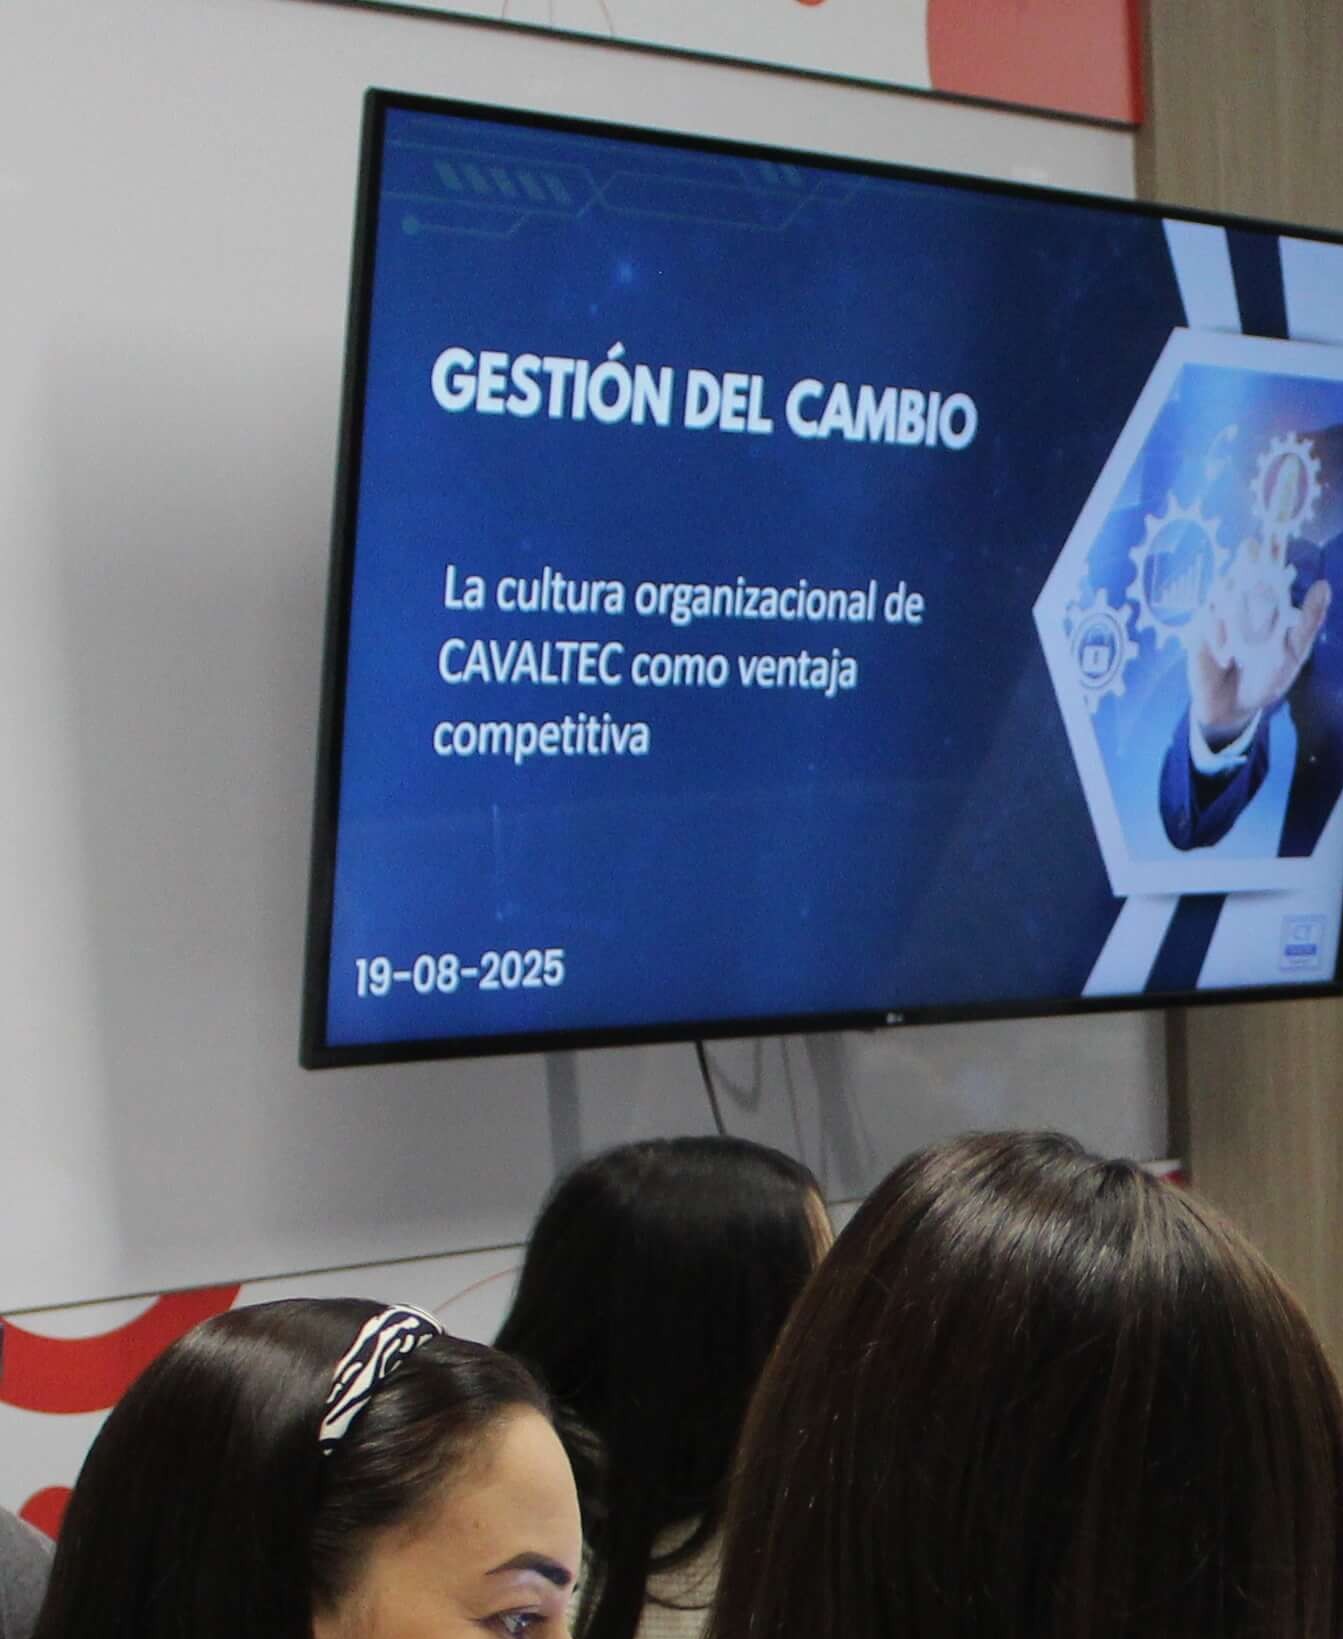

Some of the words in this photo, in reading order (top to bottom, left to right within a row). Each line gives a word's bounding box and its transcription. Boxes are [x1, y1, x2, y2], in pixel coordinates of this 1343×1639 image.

[431, 342, 672, 427] GESTIÓN
[683, 369, 772, 435] DEL
[785, 379, 978, 450] CAMBIO
[444, 565, 485, 612] La
[496, 568, 625, 616] cultura
[635, 578, 876, 626] organizacional
[883, 584, 924, 624] de
[438, 638, 622, 687] CAVALTEC
[631, 652, 728, 688] como
[737, 649, 857, 697] ventaja
[432, 711, 650, 763] competitiva
[354, 948, 565, 998] 19-08-2025
